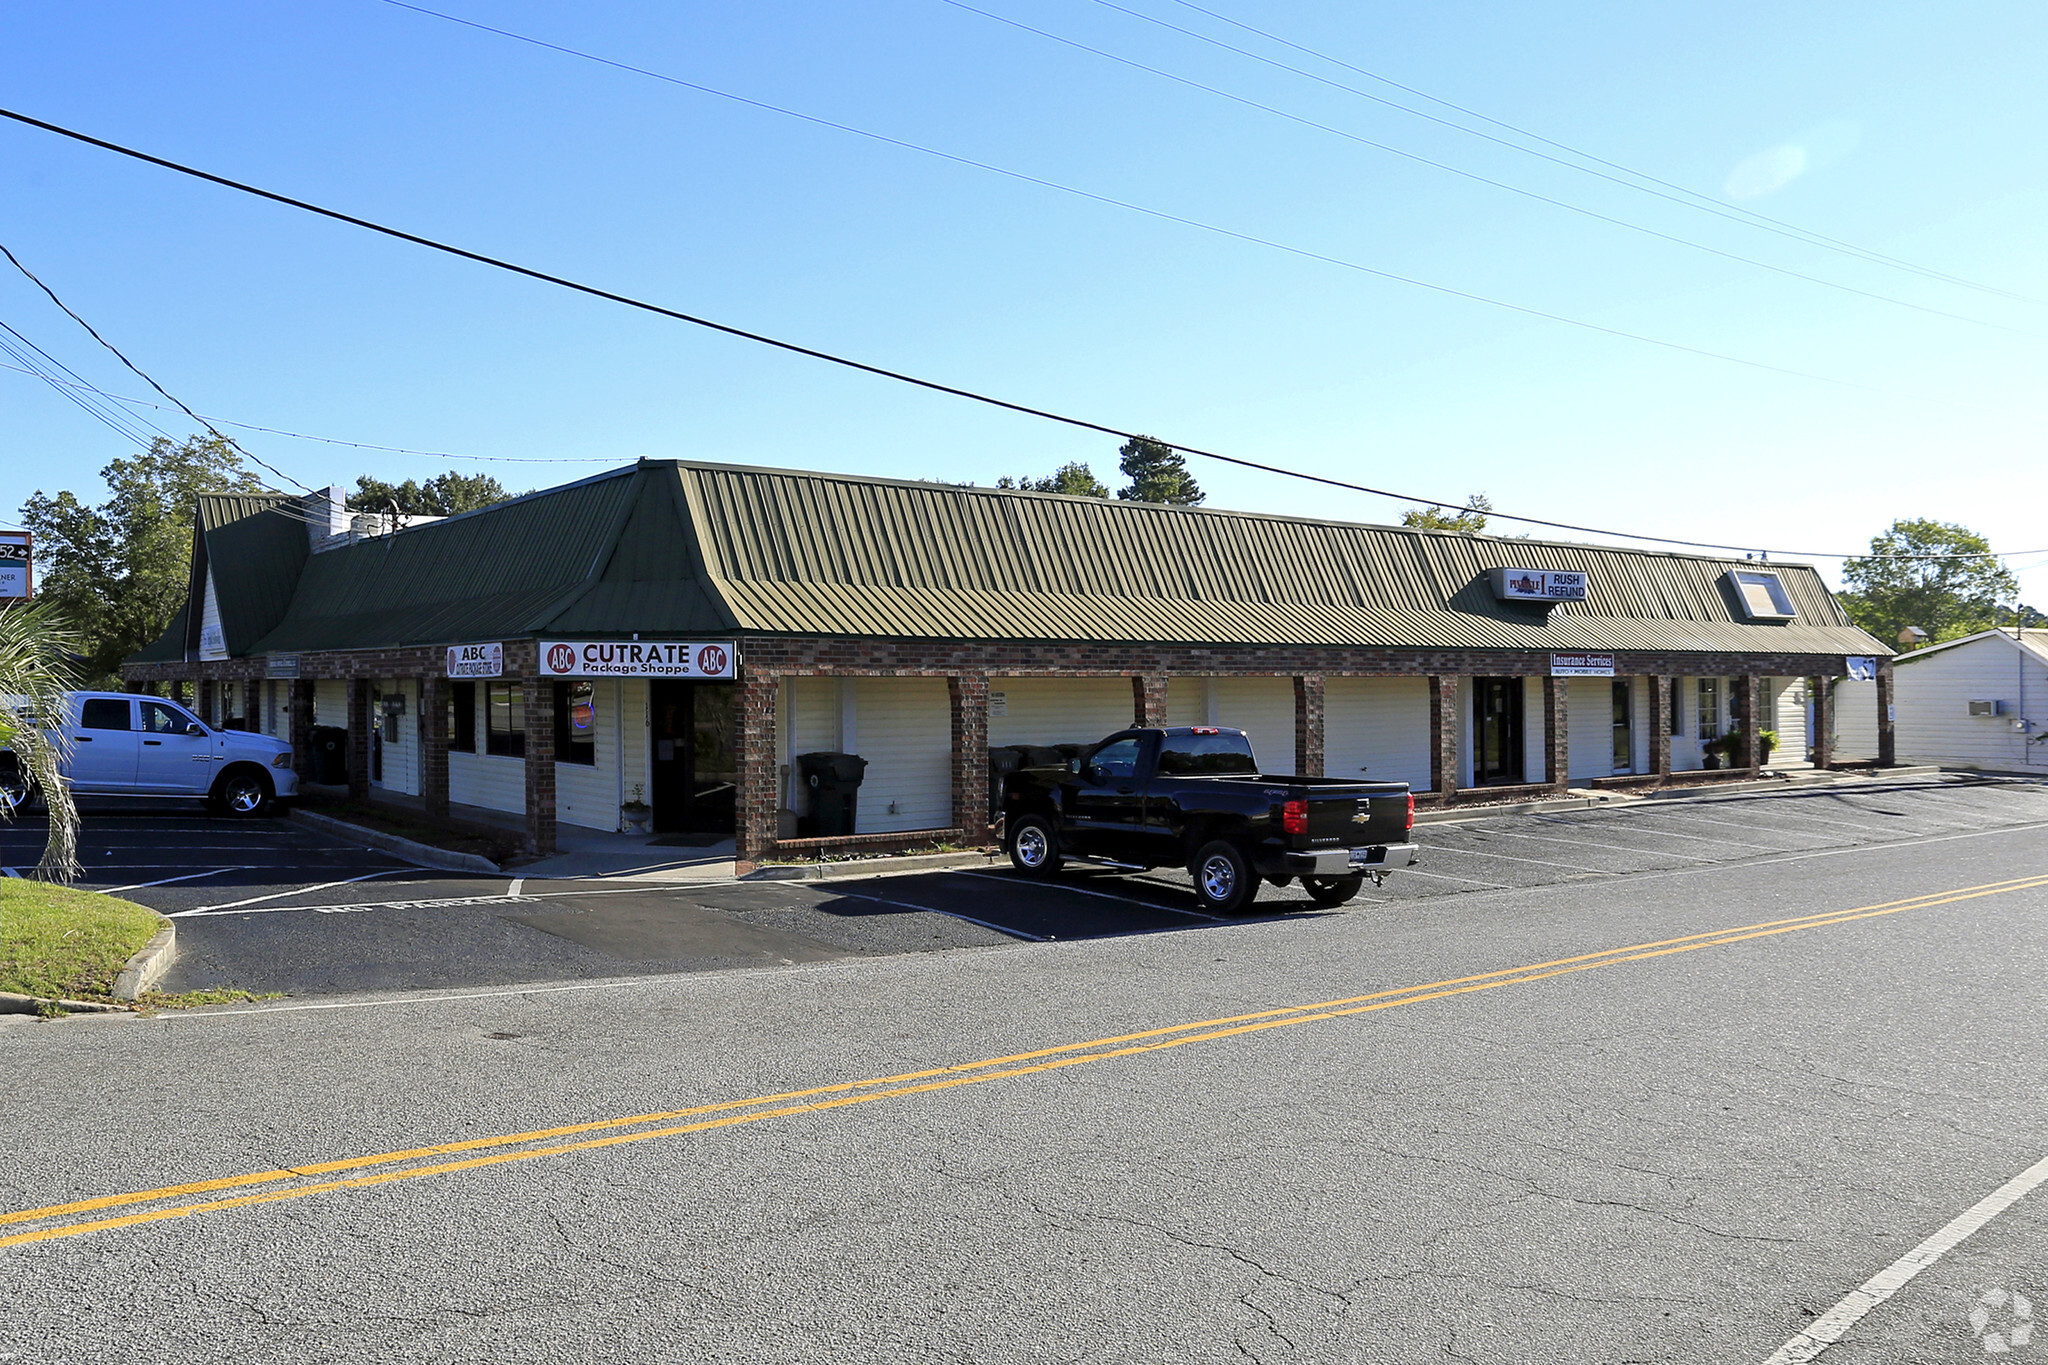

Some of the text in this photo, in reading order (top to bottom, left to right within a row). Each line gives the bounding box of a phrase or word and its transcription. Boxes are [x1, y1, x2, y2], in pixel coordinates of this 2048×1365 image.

[0, 545, 15, 559] 52
[1554, 574, 1580, 585] RUSH
[1548, 586, 1585, 597] REFUND
[462, 646, 486, 661] ABC
[551, 648, 572, 670] ABC
[582, 644, 690, 664] CUTRATE
[702, 649, 723, 671] ABC
[1553, 653, 1612, 667] Insurance Services
[583, 663, 690, 675] Package Shoppe
